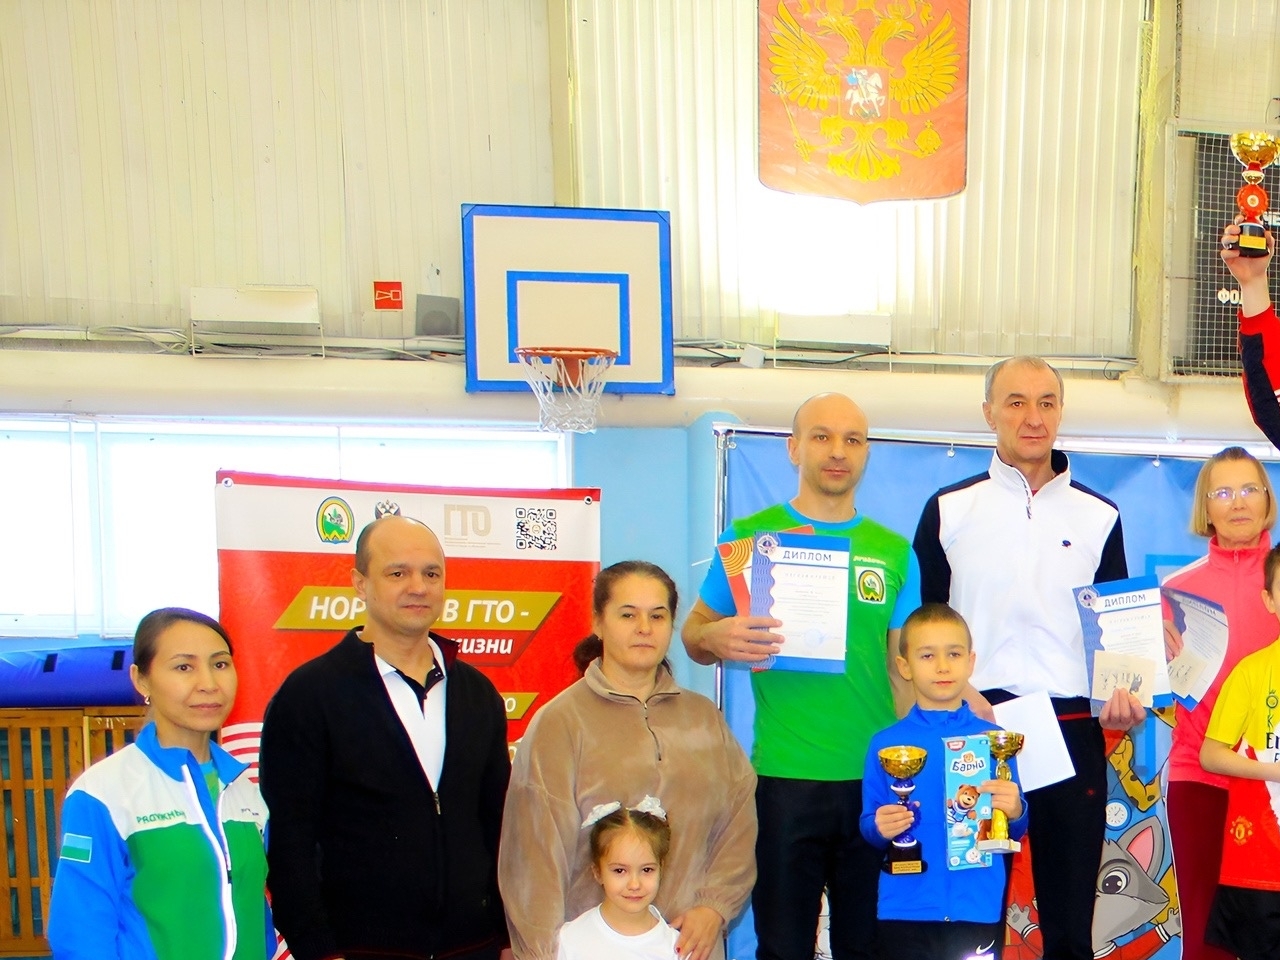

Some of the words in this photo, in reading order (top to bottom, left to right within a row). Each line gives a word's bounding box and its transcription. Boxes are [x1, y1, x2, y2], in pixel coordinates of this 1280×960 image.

[1217, 288, 1241, 305] ФО
[444, 504, 492, 537] ГТО
[783, 550, 832, 562] ДИПЛОМ
[1104, 593, 1146, 608] ДИПЛОМ
[466, 599, 515, 623] ГТО
[952, 760, 985, 772] Барни
